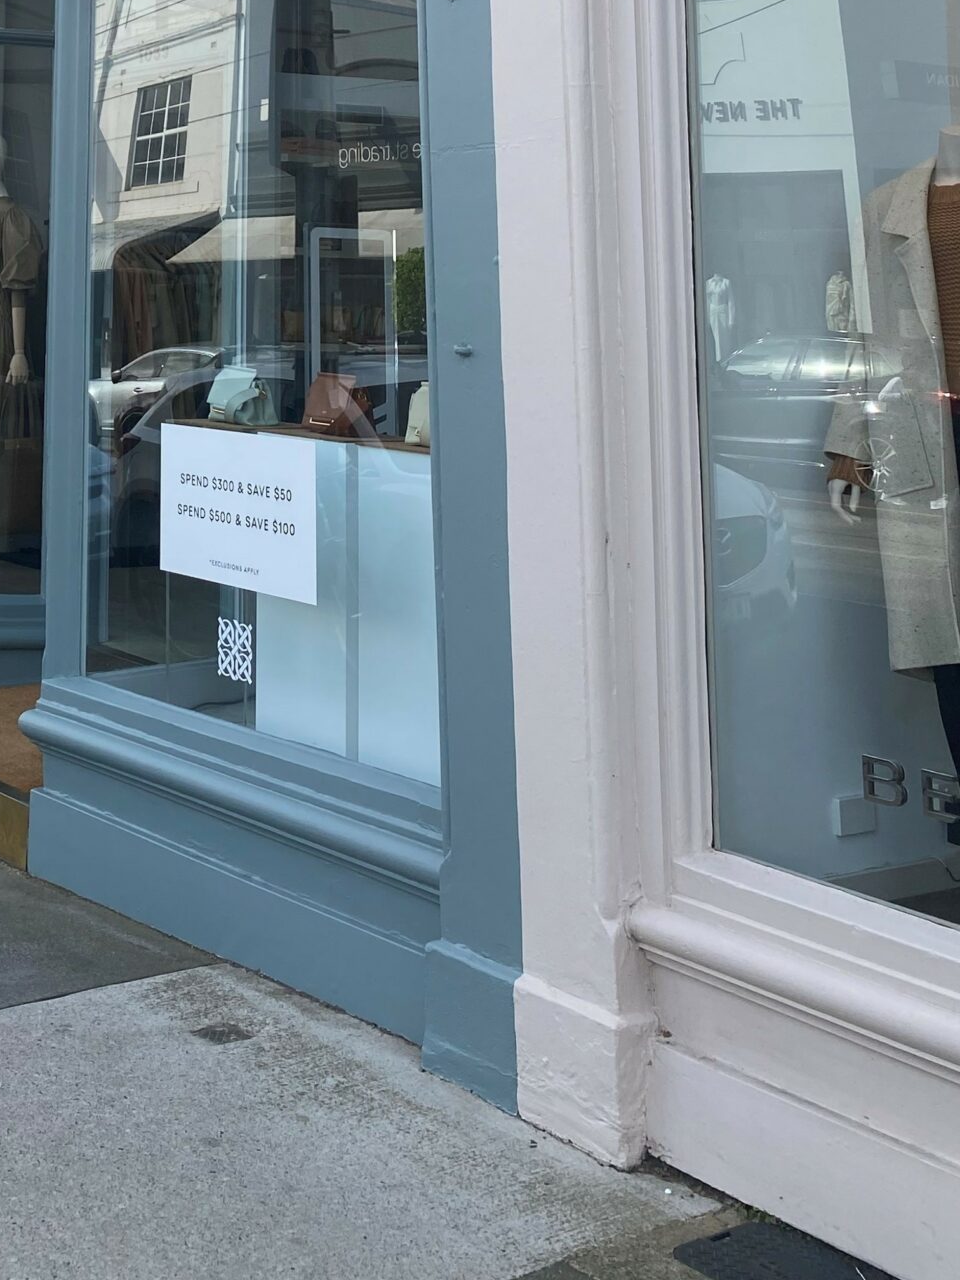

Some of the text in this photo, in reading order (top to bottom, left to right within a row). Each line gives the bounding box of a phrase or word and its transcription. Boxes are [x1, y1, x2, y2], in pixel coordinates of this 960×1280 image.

[180, 472, 292, 502] SPEND $300 & SAVE $50
[177, 503, 296, 536] SPEND $500 & SAVE $100
[243, 568, 259, 576] APPLY
